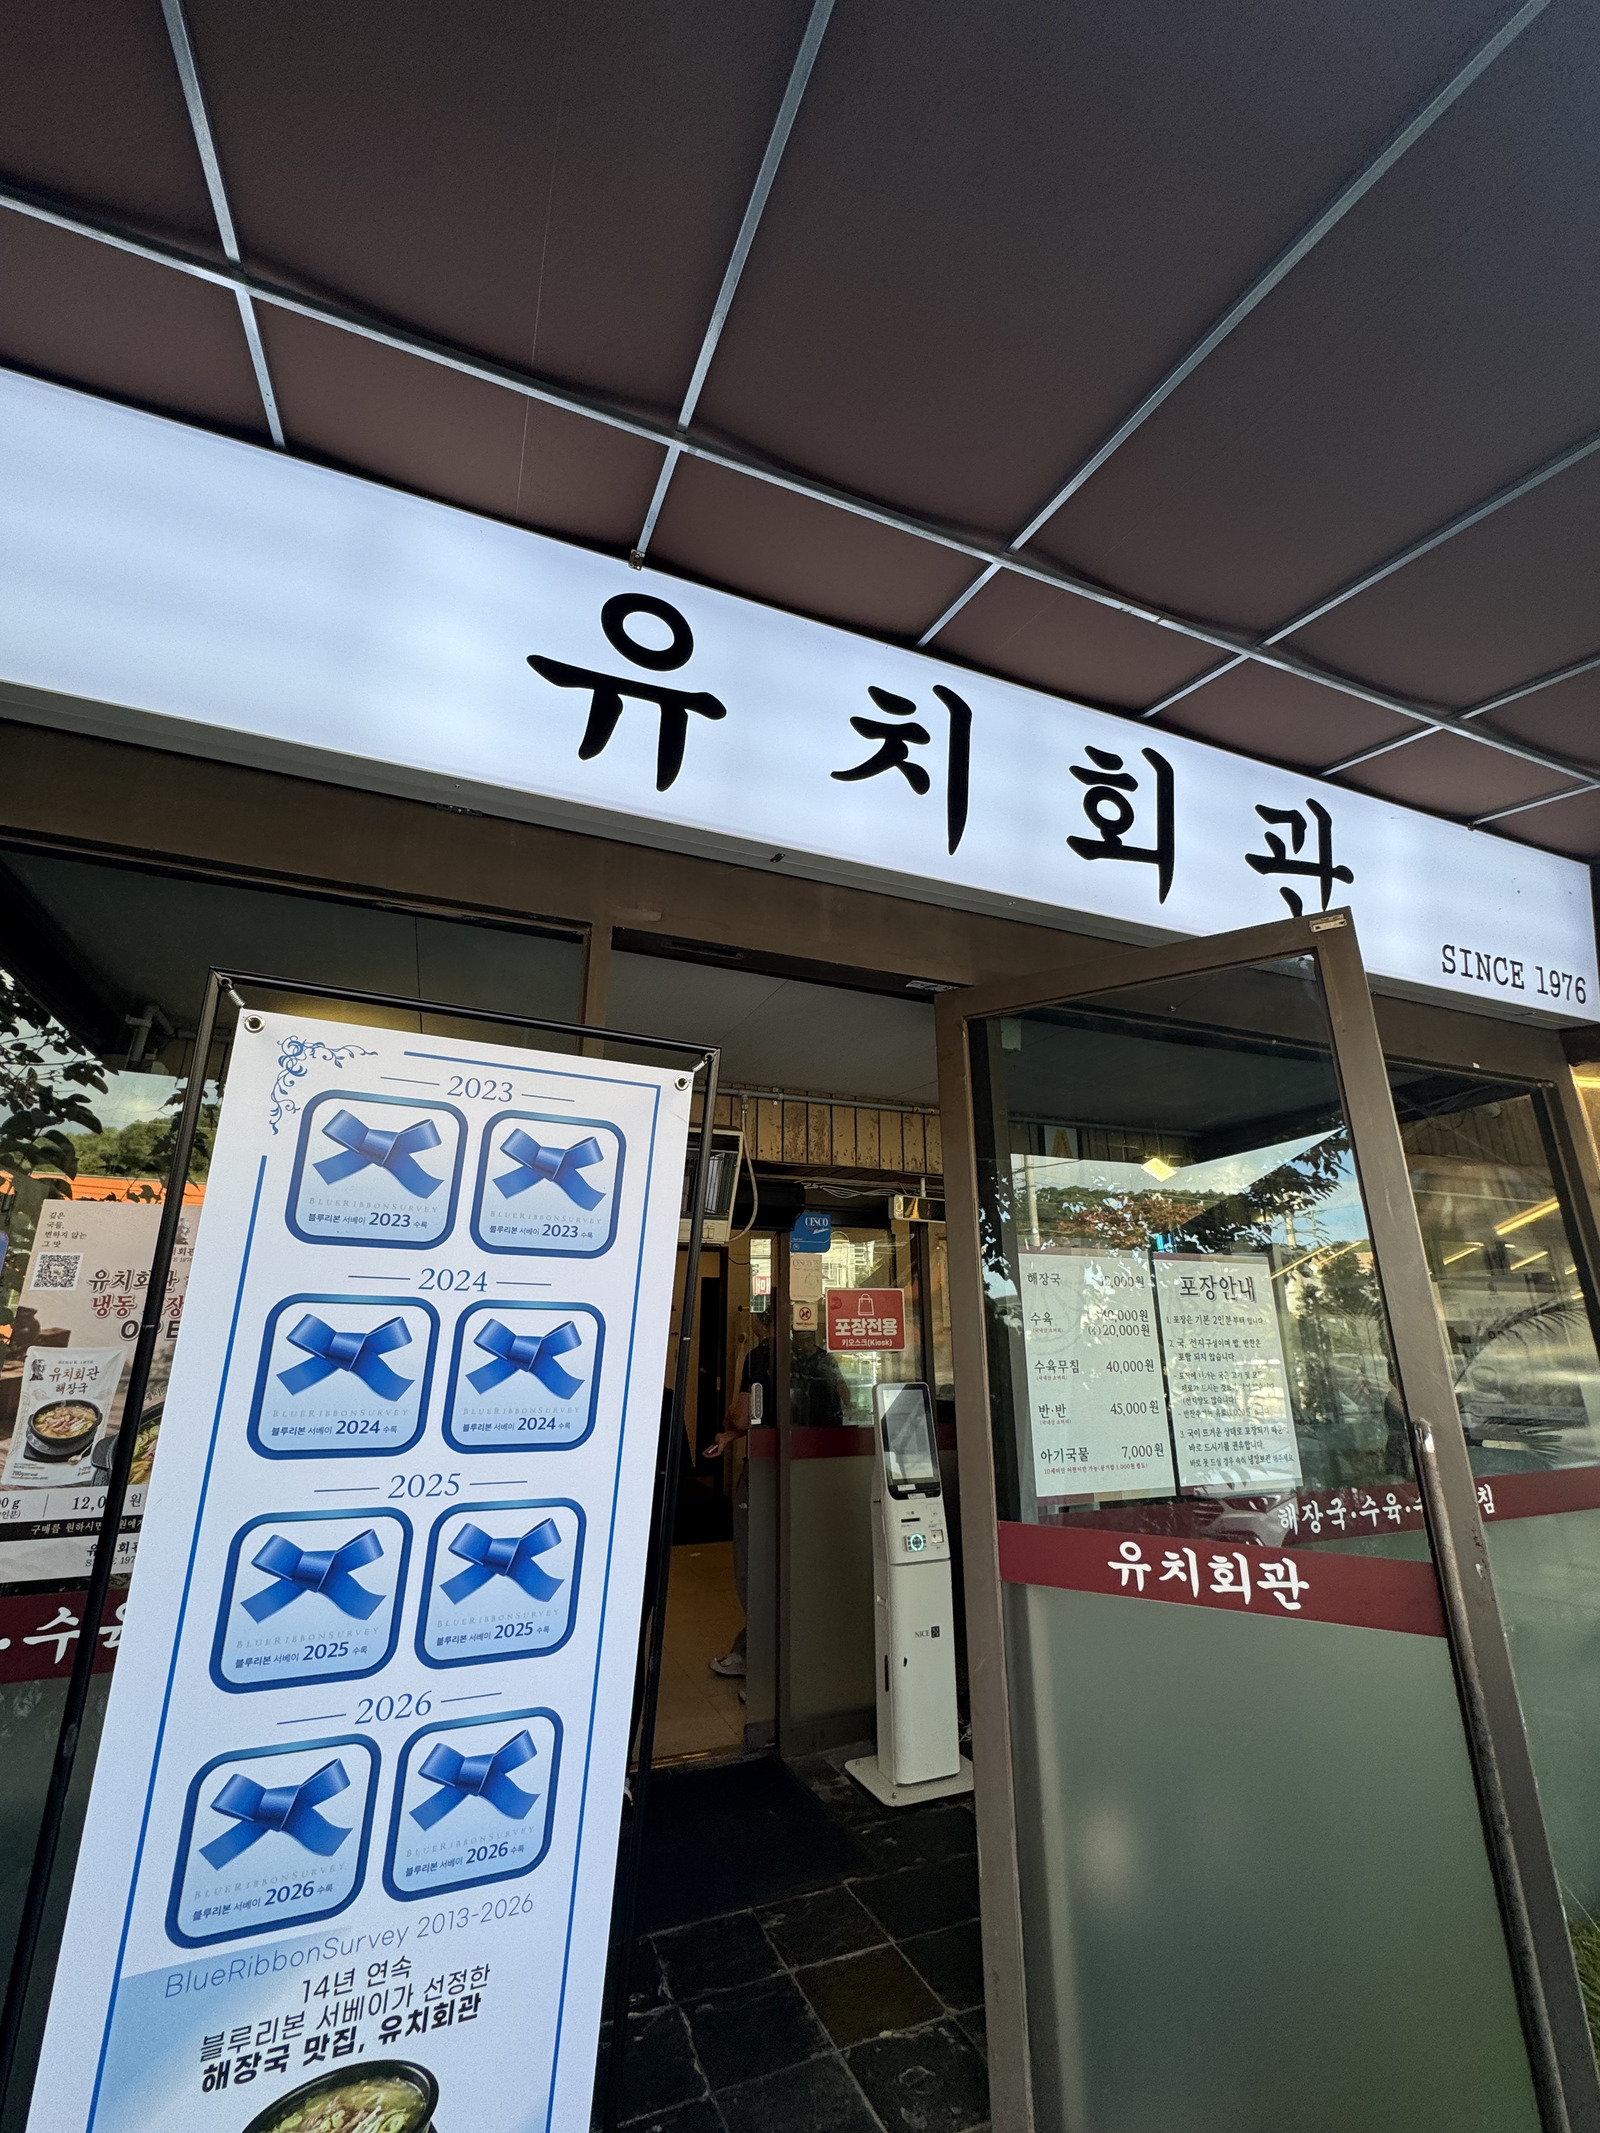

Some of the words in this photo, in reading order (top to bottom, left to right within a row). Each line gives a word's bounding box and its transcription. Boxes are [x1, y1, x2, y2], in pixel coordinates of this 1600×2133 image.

[526, 592, 1355, 917] 유치회관
[1441, 943, 1525, 990] SINCE
[1535, 965, 1587, 1004] 1976
[447, 1075, 514, 1103] 2023
[368, 1212, 411, 1227] 2023
[805, 1216, 829, 1227] CESCO
[541, 1224, 579, 1238] 2023
[417, 1267, 489, 1293] 2024
[1027, 1272, 1061, 1287] 해장국
[1179, 1275, 1257, 1303] 포장안내
[92, 1295, 135, 1318] 냉동
[835, 1317, 898, 1336] 포장전용
[1030, 1311, 1054, 1326] 수육
[1173, 1315, 1193, 1325] 포장은
[1195, 1315, 1210, 1325] 기본
[841, 1339, 893, 1347] 키오스크(Kiosk)
[49, 1365, 99, 1382] 유치회관
[1034, 1359, 1080, 1374] 수육무침
[1106, 1359, 1155, 1374] 40,000원
[55, 1382, 88, 1395] 해장국
[1038, 1403, 1067, 1419] 반·반
[335, 1420, 381, 1435] 2024
[517, 1417, 556, 1431] 2024
[1040, 1447, 1089, 1464] 아기국물
[1121, 1442, 1165, 1460] 7,000원
[387, 1472, 461, 1500] 2025
[1107, 1540, 1310, 1610] 유치회관
[493, 1621, 534, 1640] 2025
[302, 1641, 350, 1662] 2025
[354, 1690, 433, 1726] 2026
[465, 1841, 509, 1865] 2026
[264, 1880, 315, 1906] 2026
[164, 1924, 410, 1999] BlueRibbonSurvey
[416, 1893, 535, 1939] 2013-2026
[301, 1968, 357, 2004] 14년
[366, 1955, 414, 1989] 연속
[200, 2008, 307, 2063] 블루리본
[315, 1981, 415, 2032] 서베이가
[423, 1963, 491, 2003] 선정한
[200, 2044, 292, 2095] 해장국
[302, 2026, 366, 2069] 맛집,
[377, 1992, 483, 2047] 유치회관
